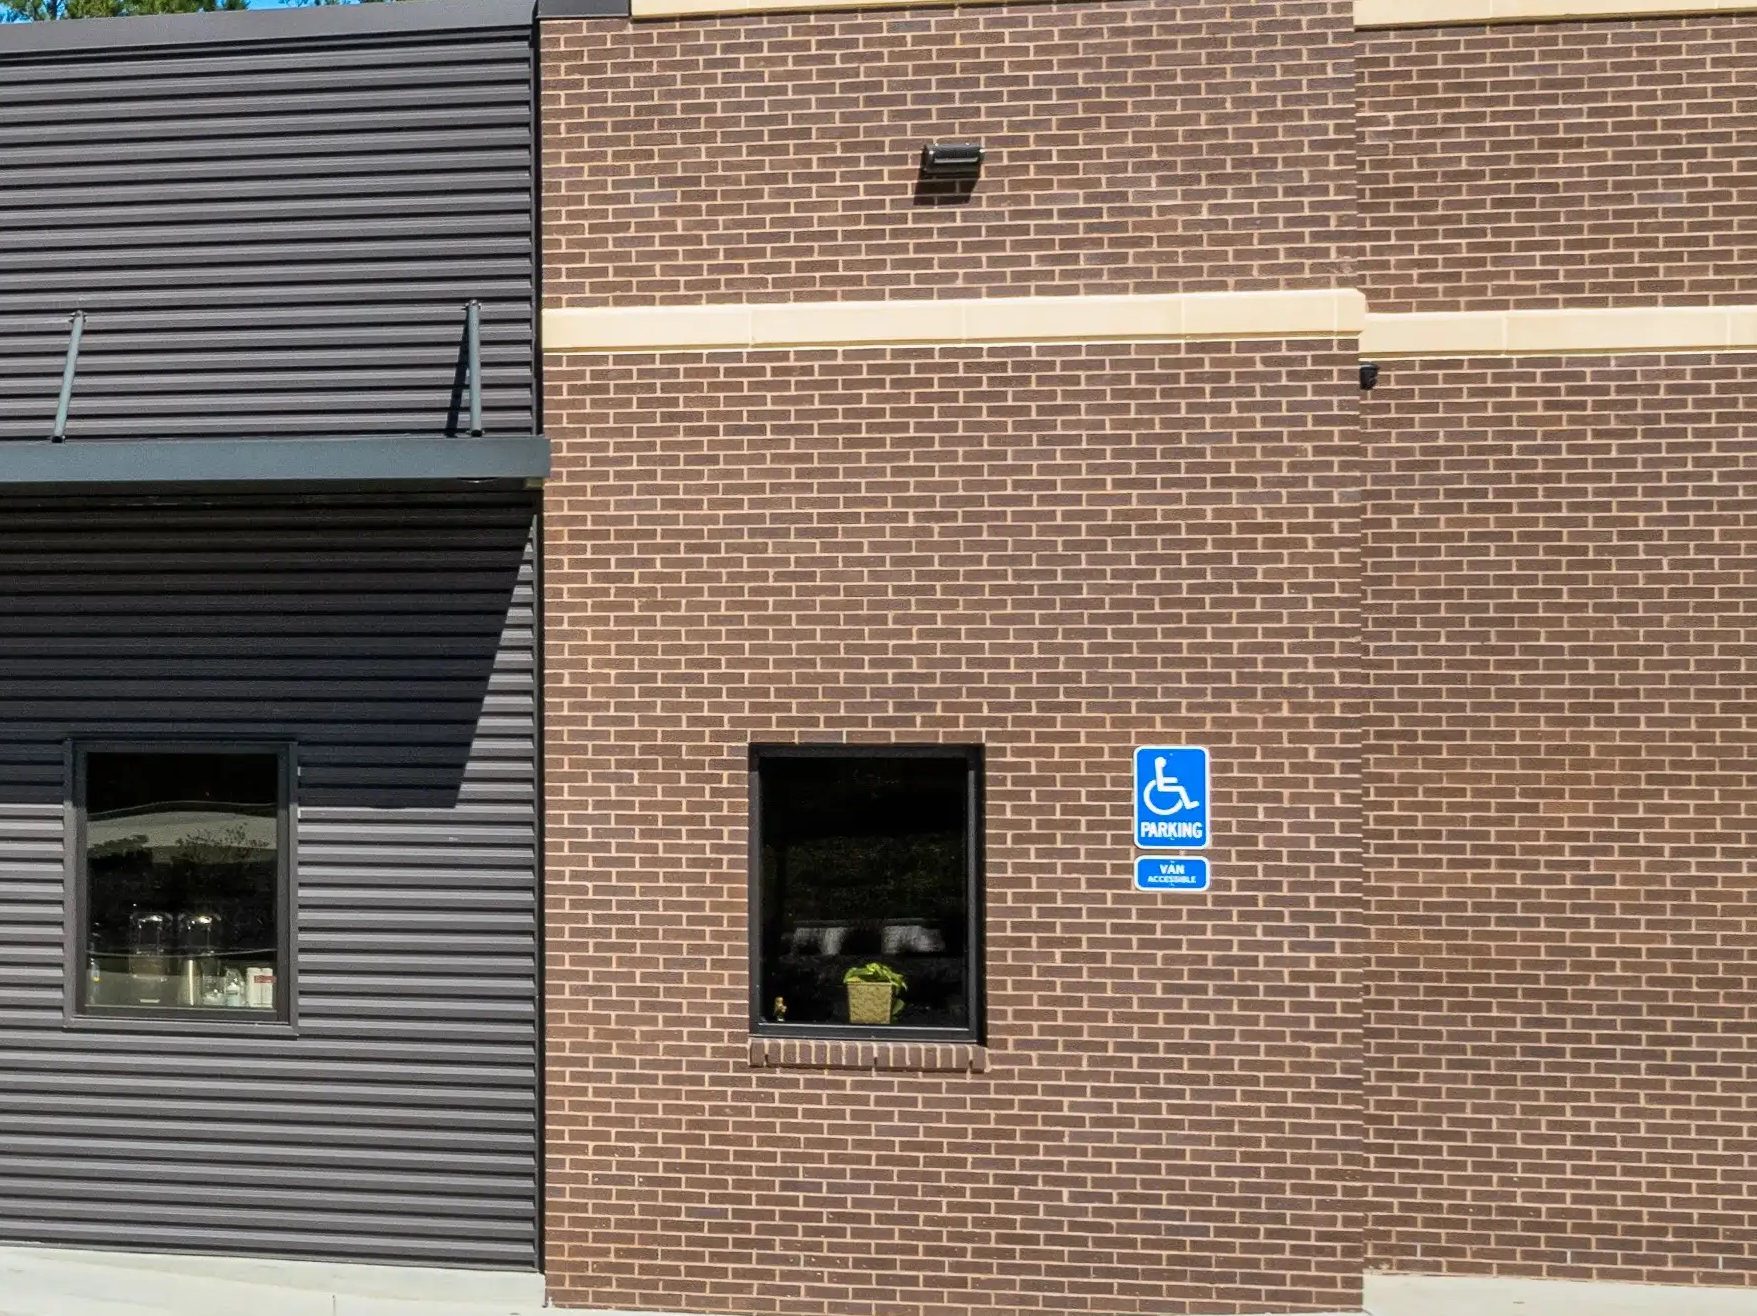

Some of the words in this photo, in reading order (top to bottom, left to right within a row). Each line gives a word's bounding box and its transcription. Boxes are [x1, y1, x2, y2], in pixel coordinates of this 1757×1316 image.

[1140, 821, 1203, 839] PARKING
[1159, 864, 1185, 875] VAN
[1147, 875, 1197, 884] ACCESSIBLE
